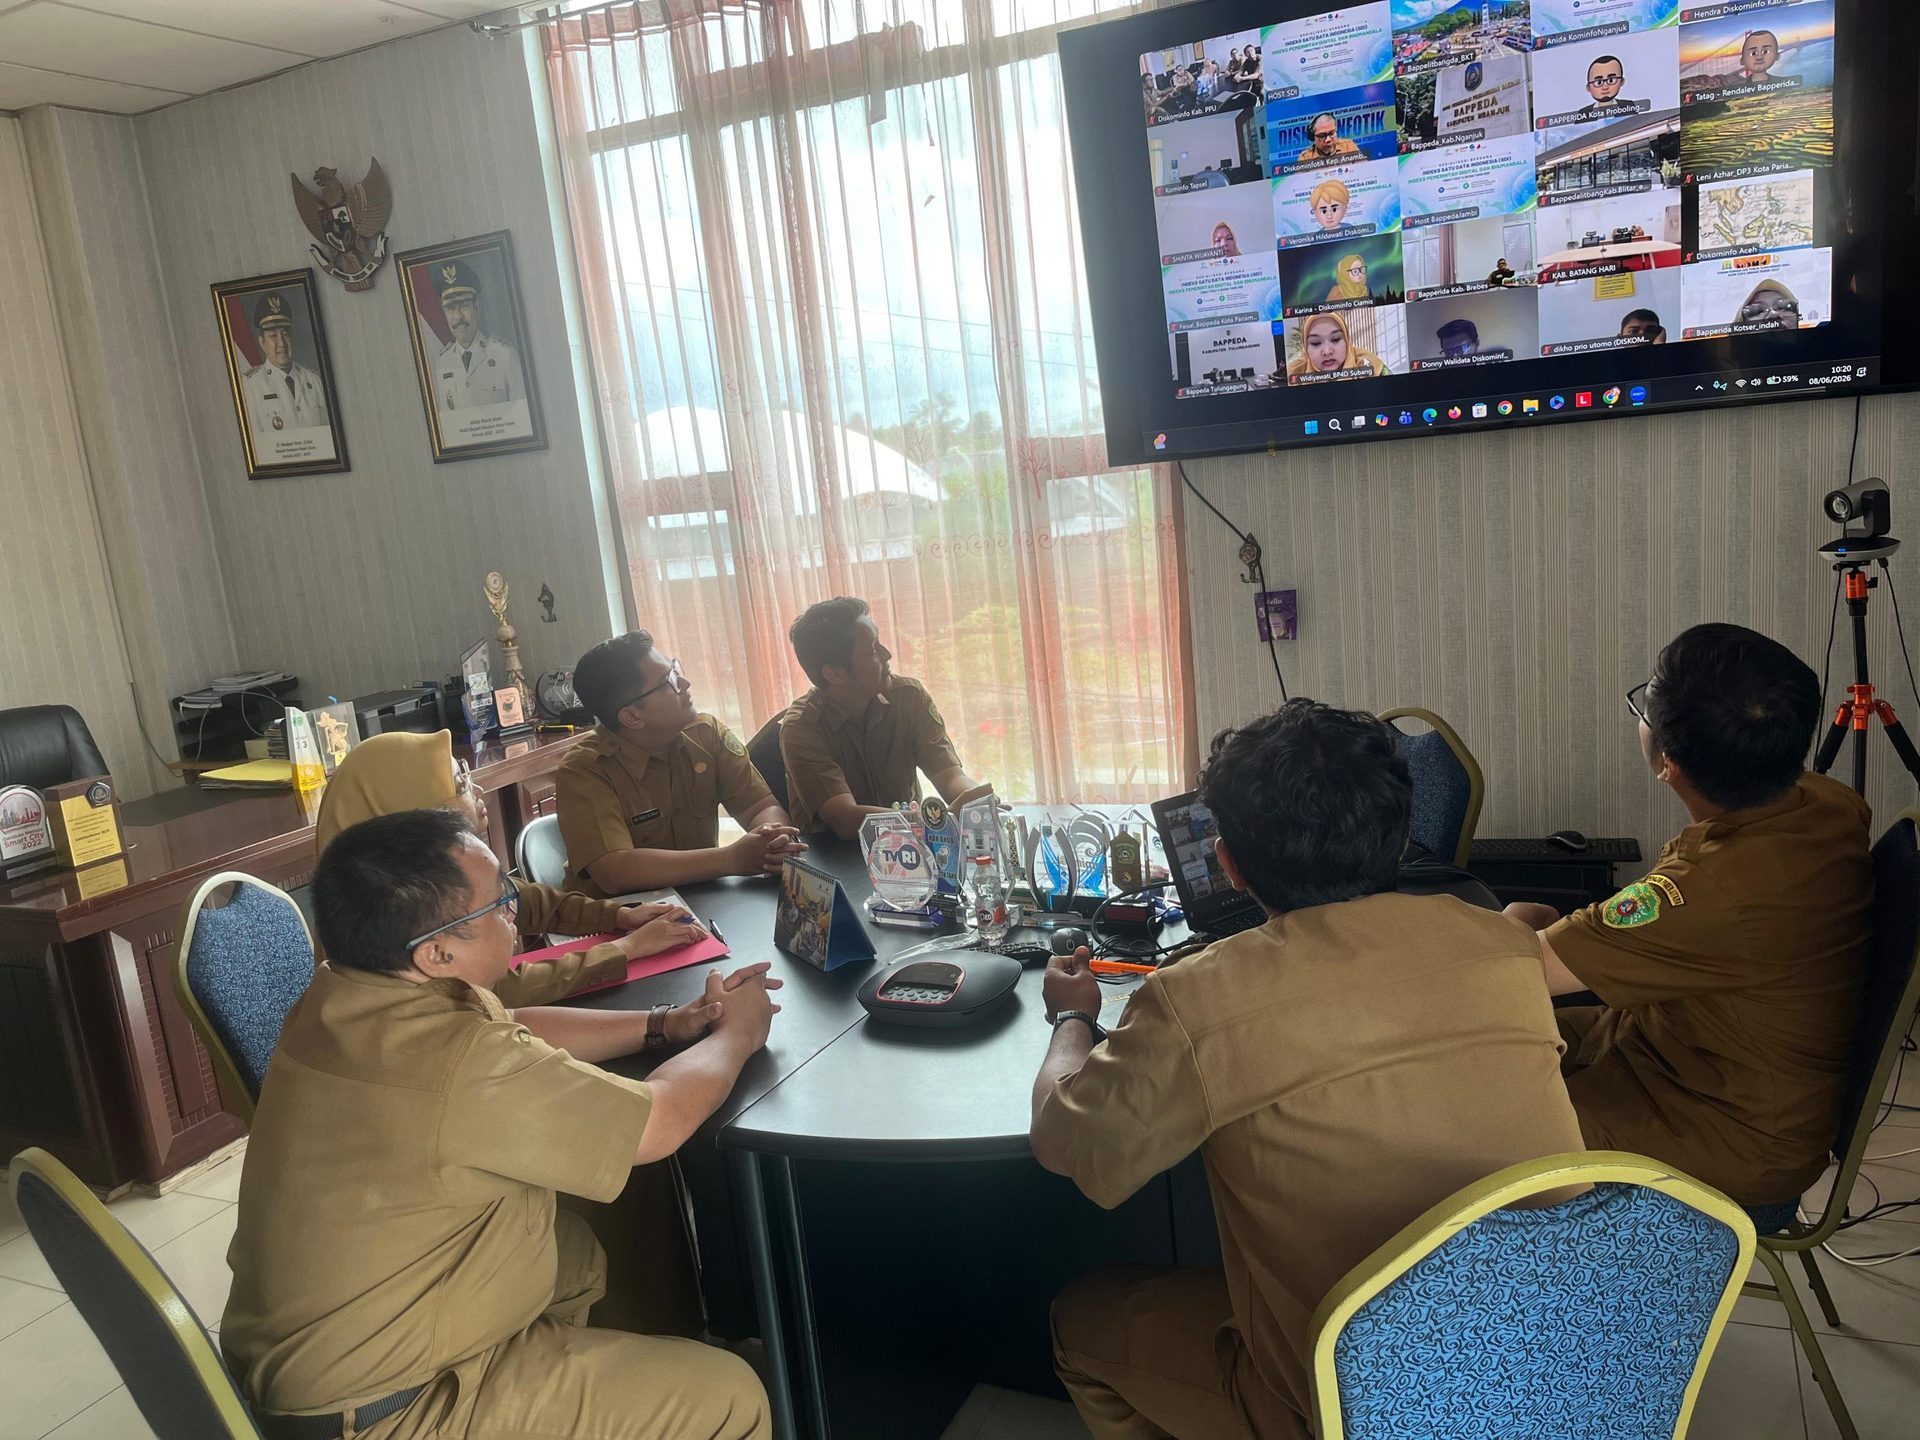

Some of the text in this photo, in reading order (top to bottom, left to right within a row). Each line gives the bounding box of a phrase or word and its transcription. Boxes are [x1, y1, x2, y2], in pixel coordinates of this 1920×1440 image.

[1694, 8, 1721, 19] Hendra
[1724, 1, 1765, 13] Diskominfo
[1547, 24, 1628, 45] Anida KominfoNganjuk
[1268, 88, 1298, 100] HOST SDI
[1696, 91, 1714, 102] Tatag
[1722, 84, 1756, 97] Rendalev
[1454, 96, 1498, 117] BAPPEDA
[1158, 104, 1217, 123] Diskominfo Kab. PPU
[1549, 112, 1587, 125] BAPPERIDA
[1588, 108, 1605, 118] Kota
[1284, 162, 1326, 173] Diskominfotik
[1696, 172, 1711, 182] Leni
[1753, 164, 1770, 173] Kota
[1166, 181, 1208, 194] Kominfo Tapsel
[1414, 216, 1430, 225] Host
[1289, 236, 1315, 245] Veronika
[1316, 232, 1343, 241] Hildawati
[1172, 250, 1224, 262] SHINTA WIJAYANTI
[1696, 246, 1757, 260] Diskominfo Aceh
[1552, 264, 1616, 279] KAB. BATANG HARI
[1418, 282, 1488, 299] Bapperida Kab. Brebes
[1294, 304, 1312, 314] Karina
[1319, 302, 1352, 312] Diskominfo
[1354, 298, 1373, 307] Ciamis
[1221, 316, 1234, 324] Kota
[1734, 320, 1779, 332] Kotser_indah
[1214, 337, 1247, 347] BAPPEDA
[1554, 344, 1573, 353] dikho
[1574, 342, 1588, 353] prio
[1590, 340, 1612, 349] utomo
[1422, 358, 1442, 368] Donny
[1444, 356, 1470, 366] Walidata
[1350, 368, 1373, 378] Subang
[1832, 366, 1852, 374] 10:20
[1782, 375, 1799, 383] 59%
[1809, 375, 1852, 385] 08/06/2026
[1186, 384, 1247, 397] Bappeda Tulungagung
[4, 832, 45, 848] Smart City
[22, 840, 42, 850] 2022
[883, 850, 917, 864] TVRI
